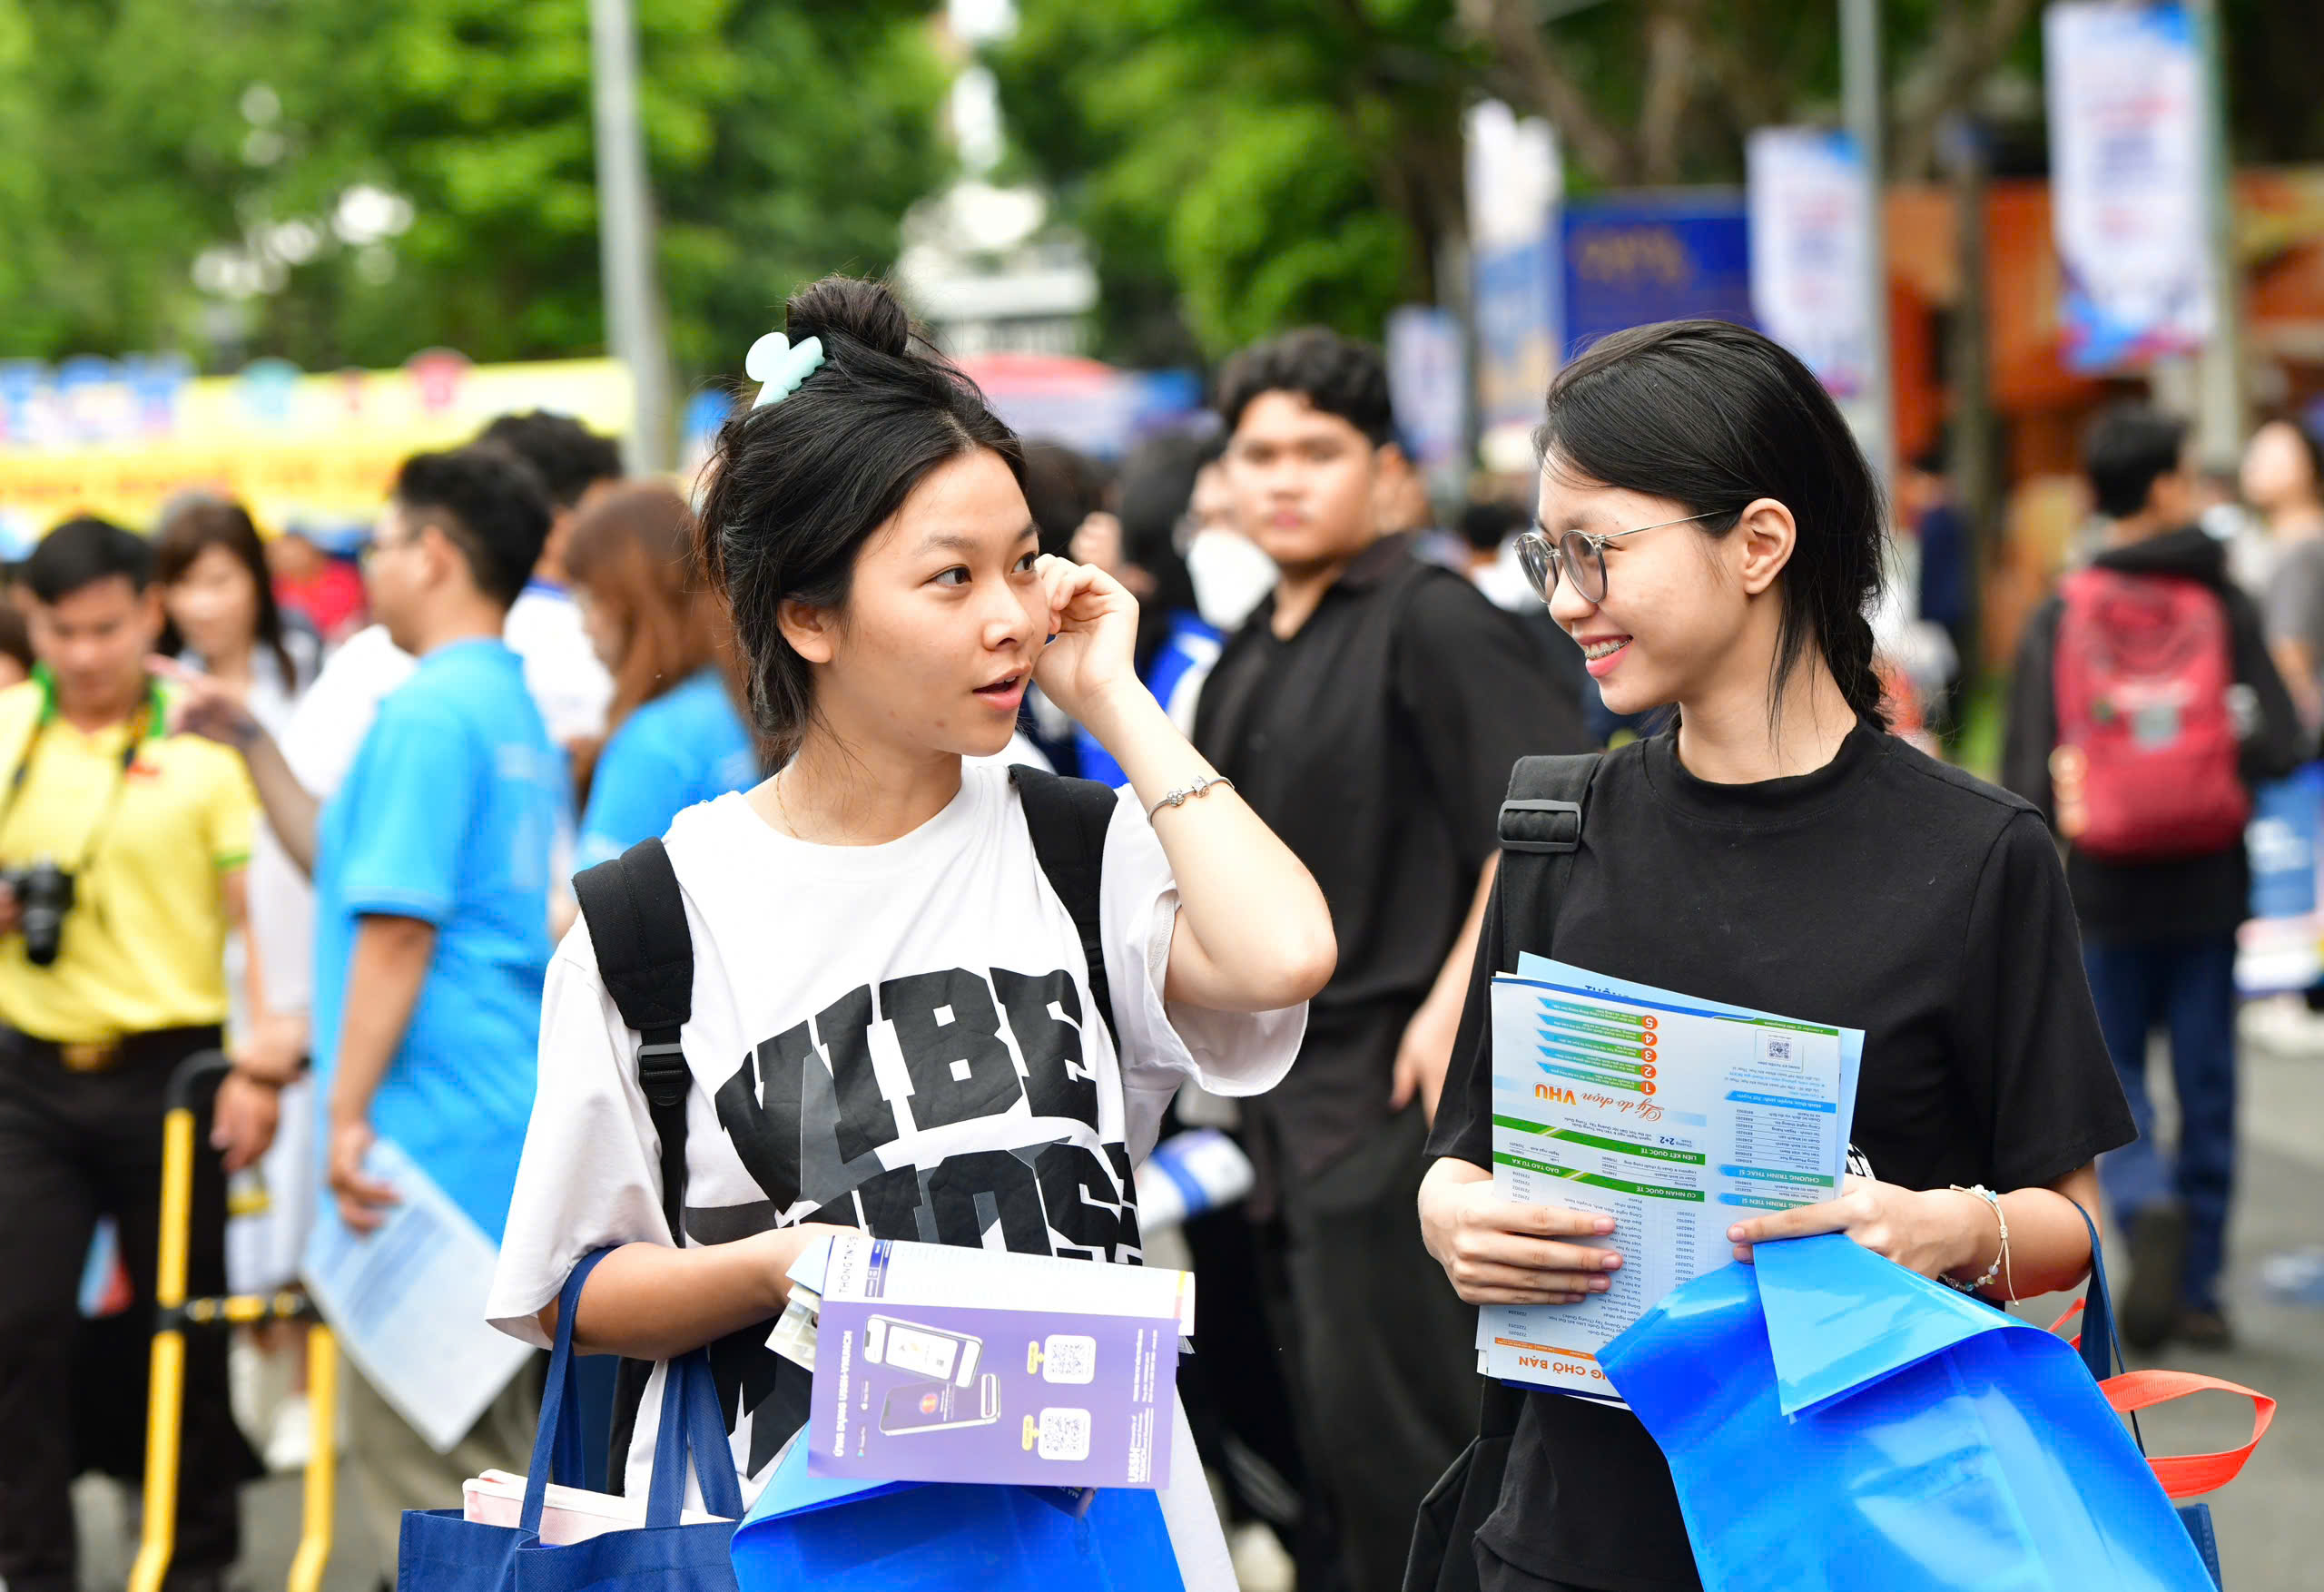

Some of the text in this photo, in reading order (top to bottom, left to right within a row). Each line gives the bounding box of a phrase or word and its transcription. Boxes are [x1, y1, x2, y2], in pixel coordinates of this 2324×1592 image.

[1645, 1018, 1652, 1027] 5
[1644, 1034, 1653, 1044] 4
[1645, 1051, 1652, 1060] 3
[1644, 1066, 1652, 1076] 2
[714, 967, 1099, 1215] VIBE
[1644, 1083, 1650, 1093] 1
[1533, 1083, 1664, 1121] Lý do chọn VHU
[1659, 1136, 1674, 1145] 2+2
[1519, 1356, 1547, 1369] BẠN
[1552, 1362, 1585, 1375] CHỜ
